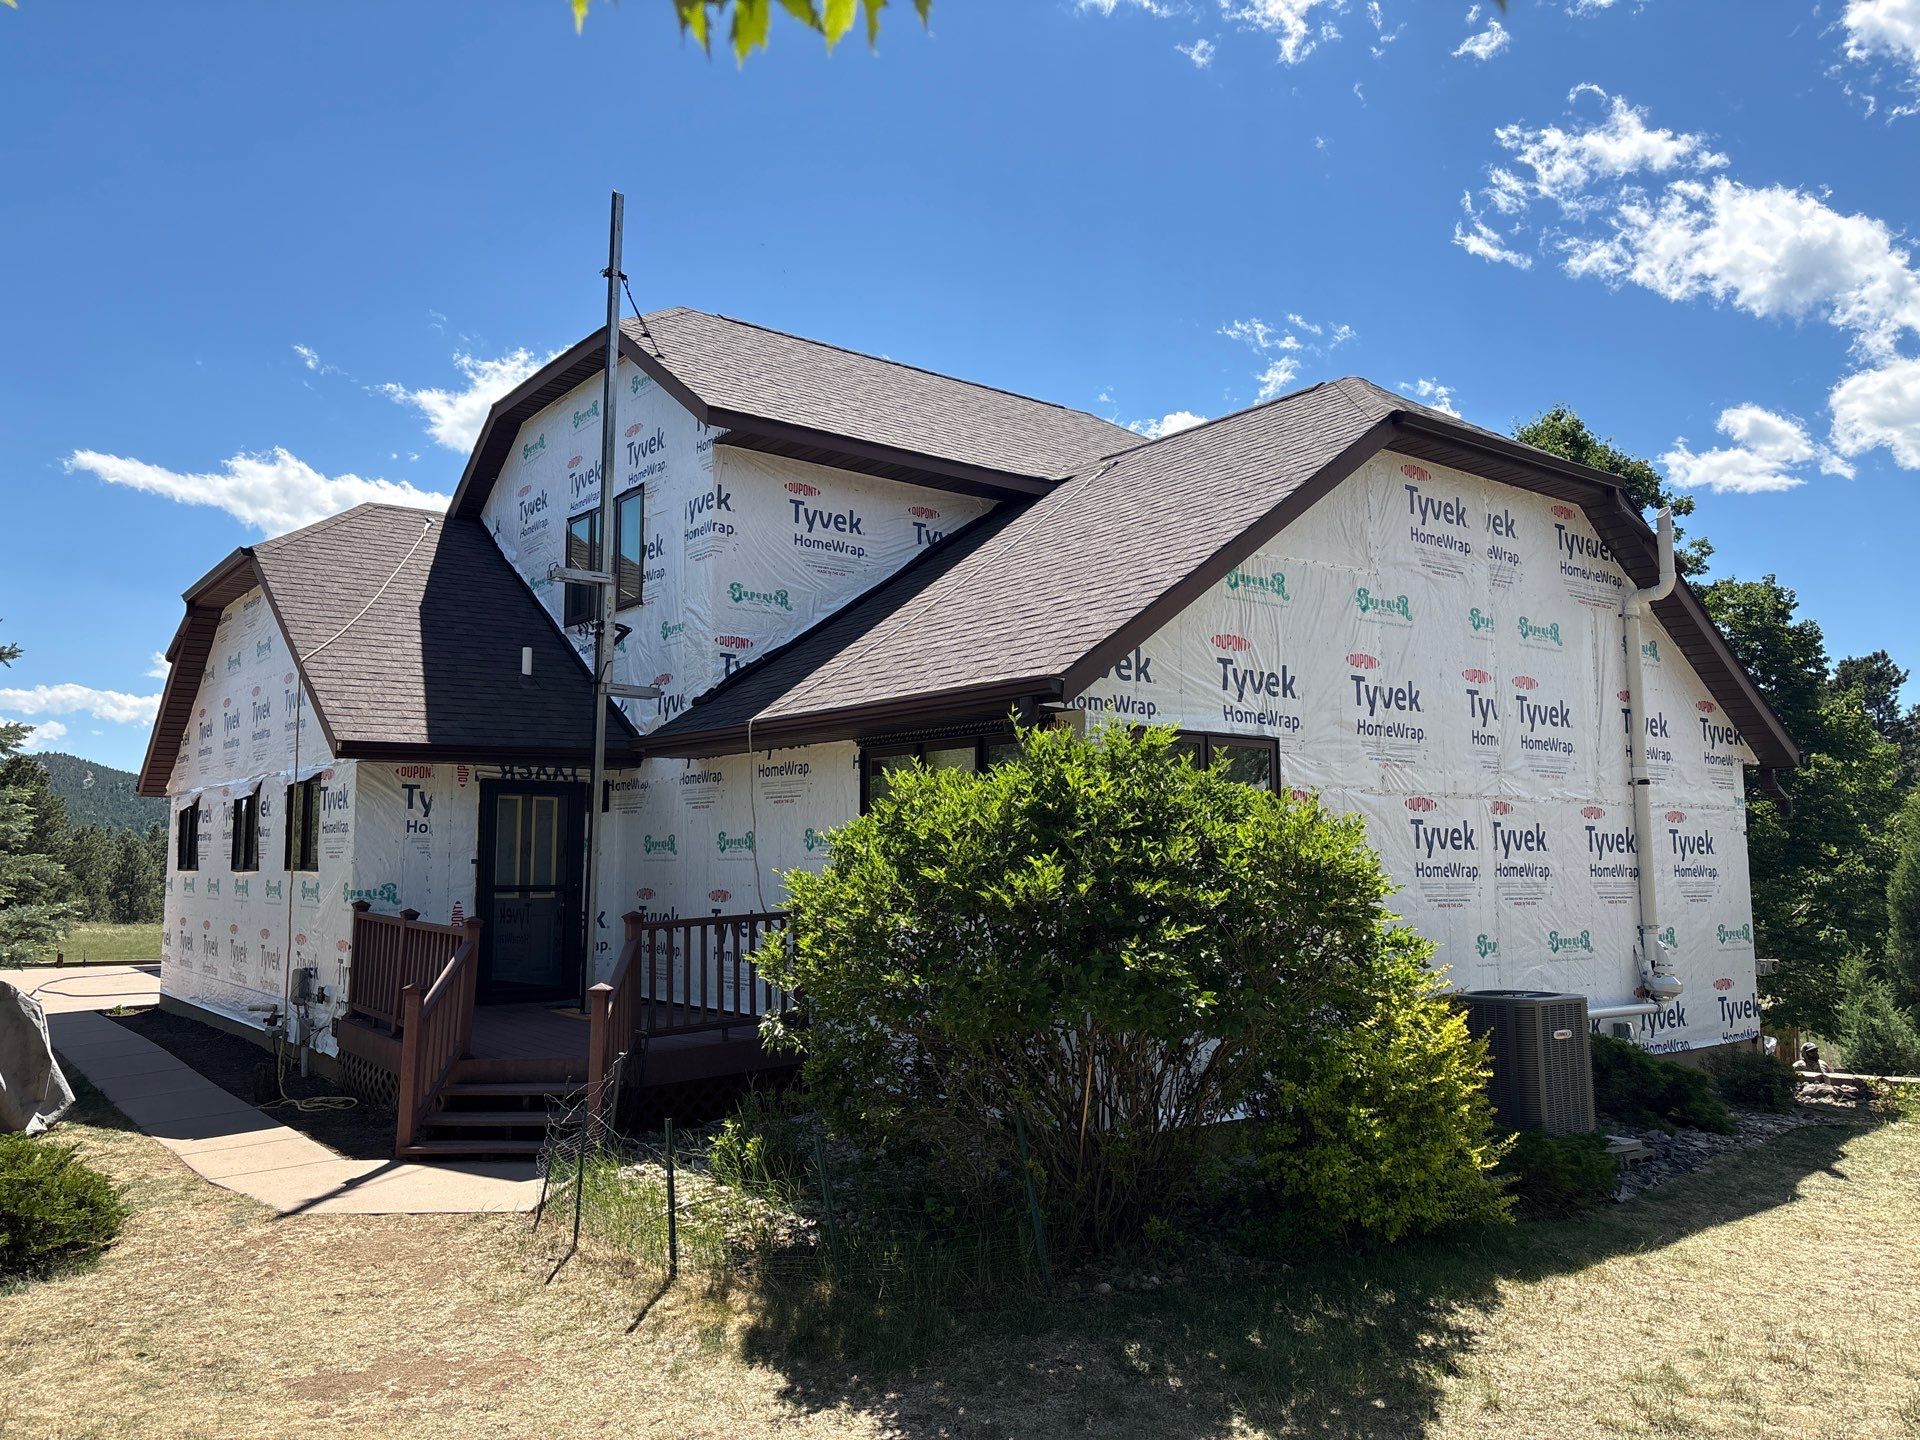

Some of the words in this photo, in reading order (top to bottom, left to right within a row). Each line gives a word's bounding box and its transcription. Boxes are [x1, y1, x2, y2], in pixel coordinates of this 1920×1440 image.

[627, 427, 665, 468] Tyvek
[569, 460, 602, 498] Tyvek
[628, 460, 667, 487] HomeWrap
[1404, 464, 1428, 482] DUPONT
[788, 482, 818, 497] DUPONT
[519, 490, 548, 524] Tyvek
[790, 499, 862, 536] Tyvek
[911, 506, 938, 519] DUPONT
[1404, 484, 1468, 528] Tyvek
[520, 518, 549, 539] HomeWrap
[1410, 527, 1471, 556] HomeWrap
[793, 533, 865, 559] HomeWrap
[1487, 545, 1520, 566] eWrap
[719, 635, 750, 650] DUPONT
[1215, 634, 1247, 651] DUPONT
[1350, 653, 1377, 669] DUPONT
[1217, 657, 1297, 702] Tyvek
[1350, 675, 1422, 716] Tyvek
[223, 707, 240, 736] Tyvek
[252, 696, 271, 729] Tyvek
[1223, 705, 1300, 732] HomeWrap
[1516, 695, 1571, 732] Tyvek
[198, 718, 214, 745] Tyvek
[1357, 719, 1424, 743] HomeWrap
[1700, 718, 1744, 749] Tyvek
[1521, 735, 1573, 756] HomeWrap
[401, 766, 432, 779] DUPON
[758, 761, 810, 778] HomeWrap
[320, 784, 349, 818] Tyvek
[1408, 797, 1434, 812] DUPONT
[321, 820, 349, 837] HomeWrap
[1410, 818, 1475, 858] Tyvek
[1493, 821, 1547, 859] Tyvek
[1585, 826, 1636, 860] Tyvek
[1669, 828, 1714, 861] Tyvek
[1416, 862, 1478, 880] HomeWrap
[1496, 863, 1551, 881] HomeWrap
[1590, 863, 1639, 880] HomeWrap
[1674, 864, 1718, 880] HomeWrap
[180, 930, 193, 955] Tyvek
[203, 934, 218, 960] Tyvek
[230, 939, 248, 968] Tyvek
[261, 944, 281, 973] Tyvek
[1718, 993, 1760, 1028] Tyvek
